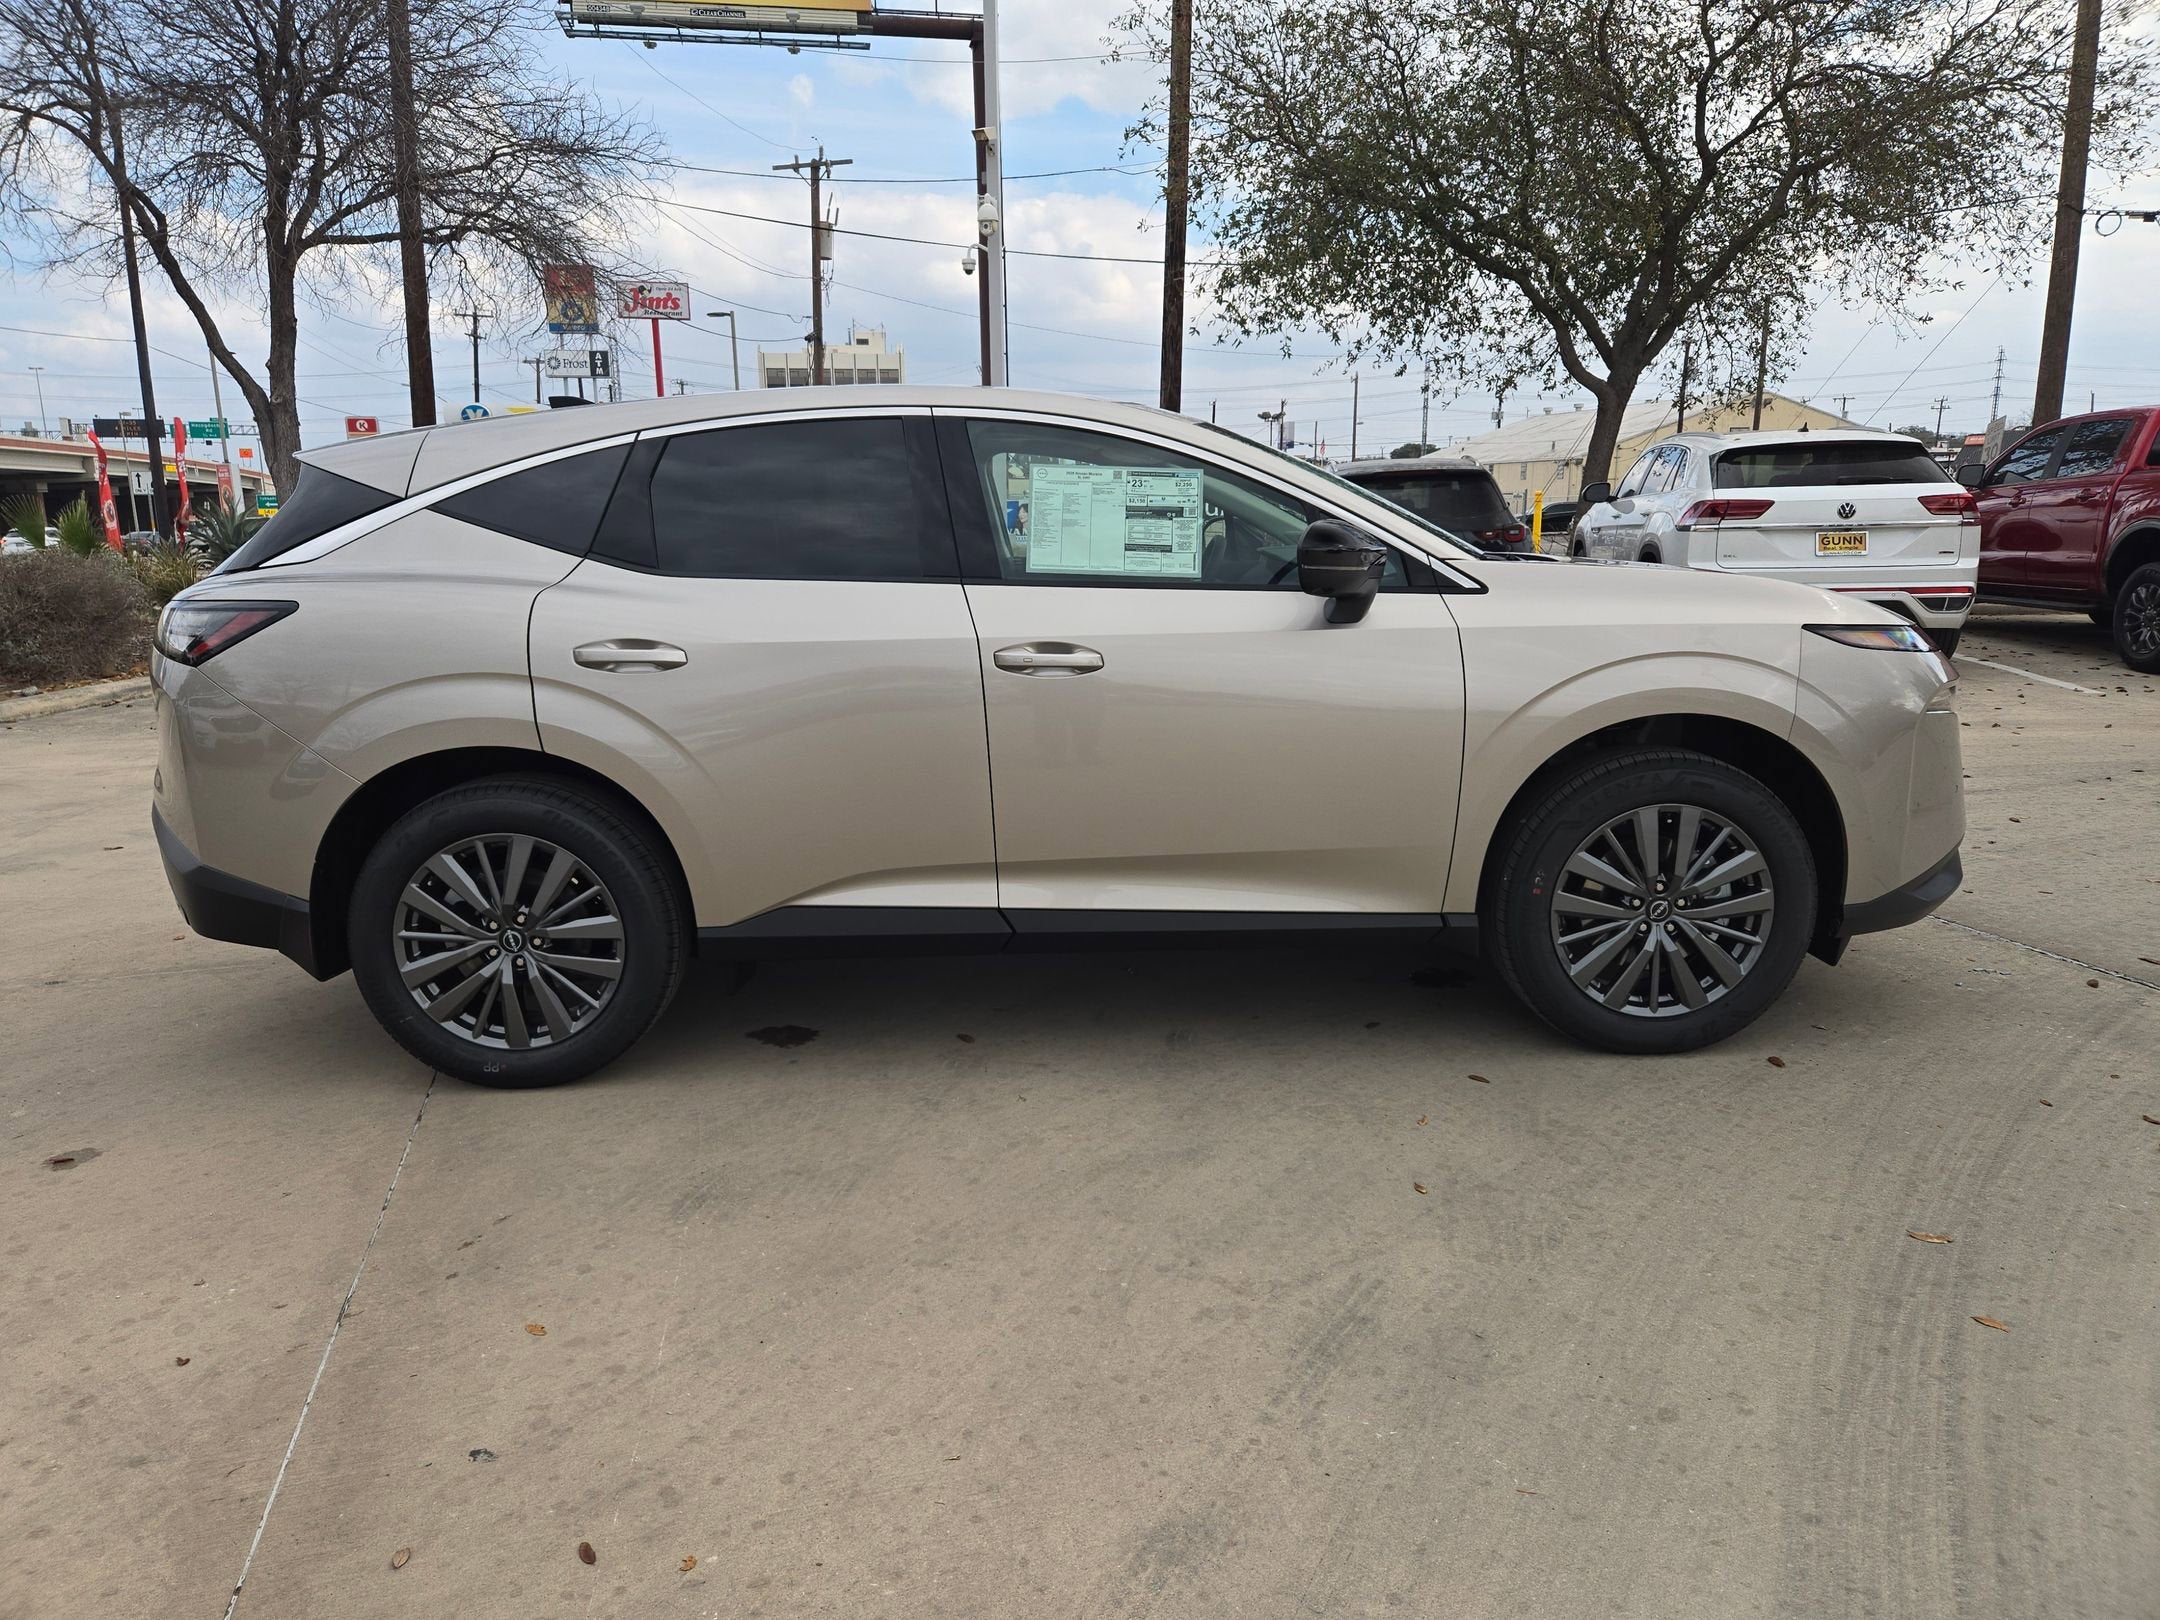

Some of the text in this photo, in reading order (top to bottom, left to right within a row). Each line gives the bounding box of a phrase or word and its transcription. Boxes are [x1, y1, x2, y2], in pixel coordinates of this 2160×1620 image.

[623, 287, 681, 313] Jim's
[562, 357, 589, 369] Frost
[595, 352, 604, 375] ATM
[1131, 479, 1143, 488] 23
[1821, 536, 1863, 546] GUNN
